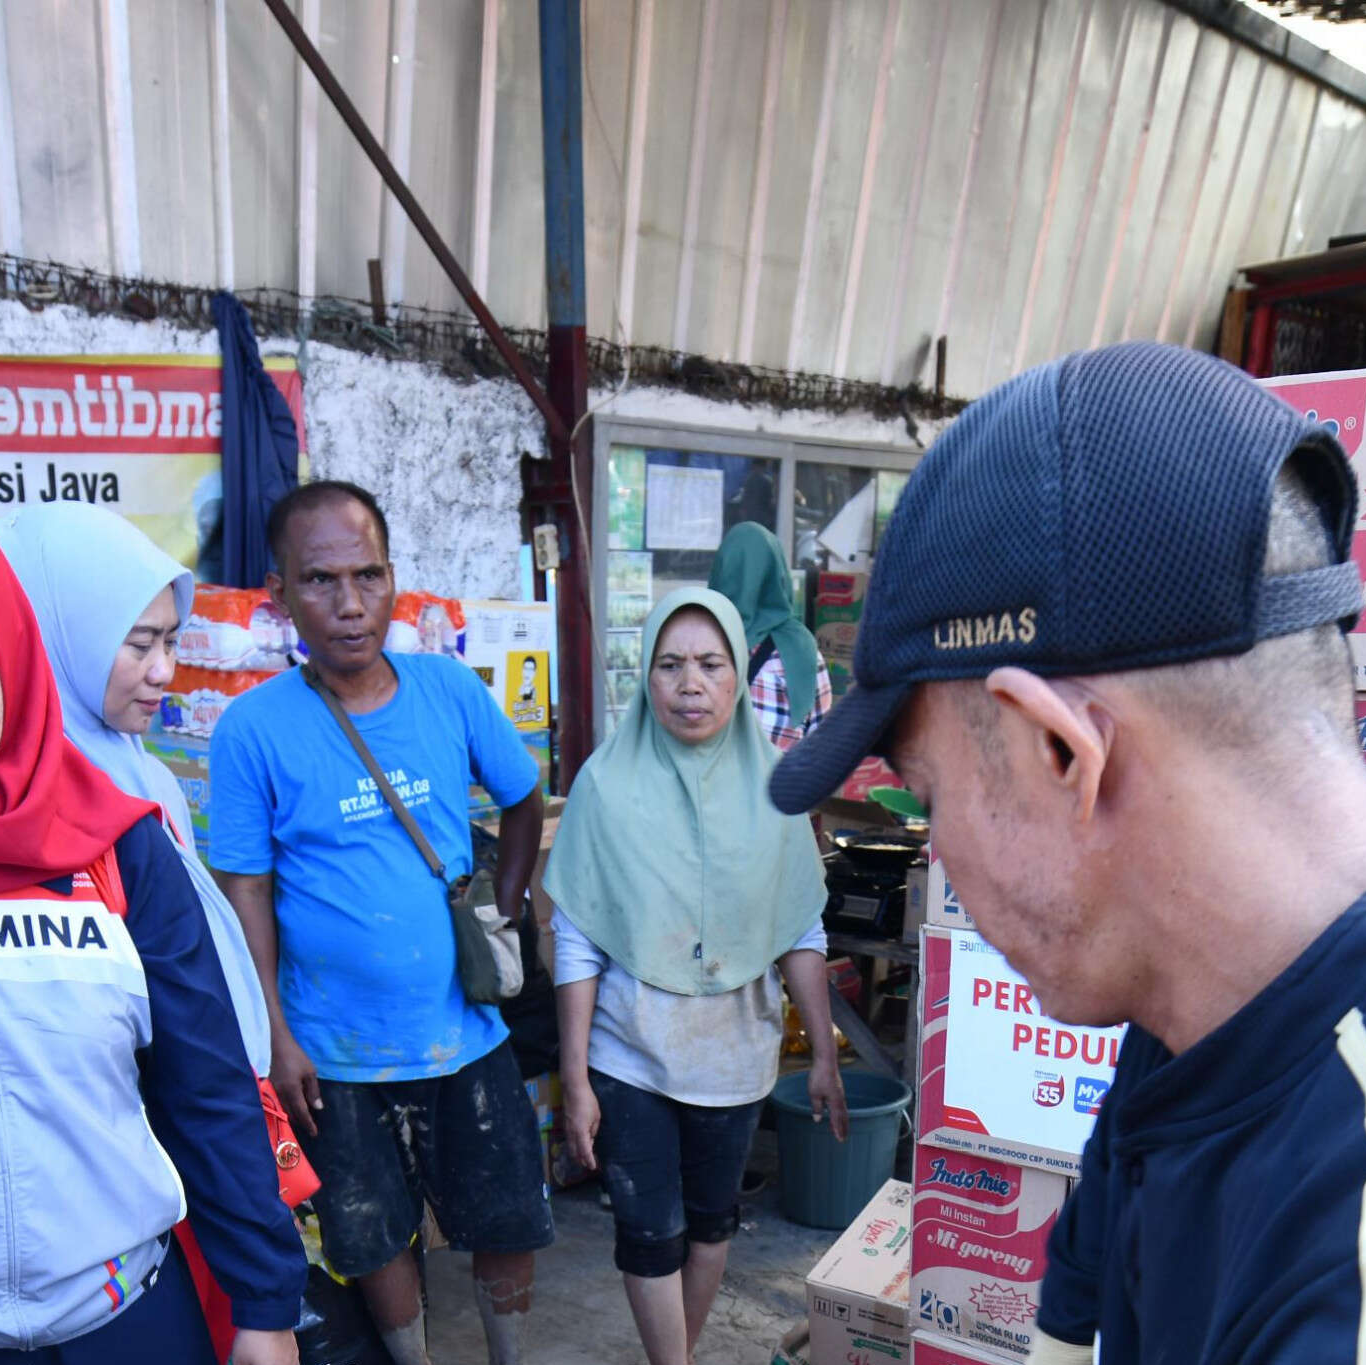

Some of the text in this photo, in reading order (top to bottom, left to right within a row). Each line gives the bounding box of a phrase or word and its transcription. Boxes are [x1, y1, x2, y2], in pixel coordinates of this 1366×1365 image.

[934, 607, 1037, 650] LINMAS
[356, 768, 408, 793] KEUA
[339, 792, 377, 814] RT.04
[394, 778, 431, 800] W.08
[1012, 1023, 1121, 1068] PEDUL
[1076, 1083, 1107, 1103] My
[978, 1143, 988, 1151] PT
[1046, 1158, 1073, 1169] SUKSES
[954, 1208, 986, 1227] Instan
[927, 1227, 1033, 1276] Mi goreng
[1015, 1332, 1031, 1345] MD
